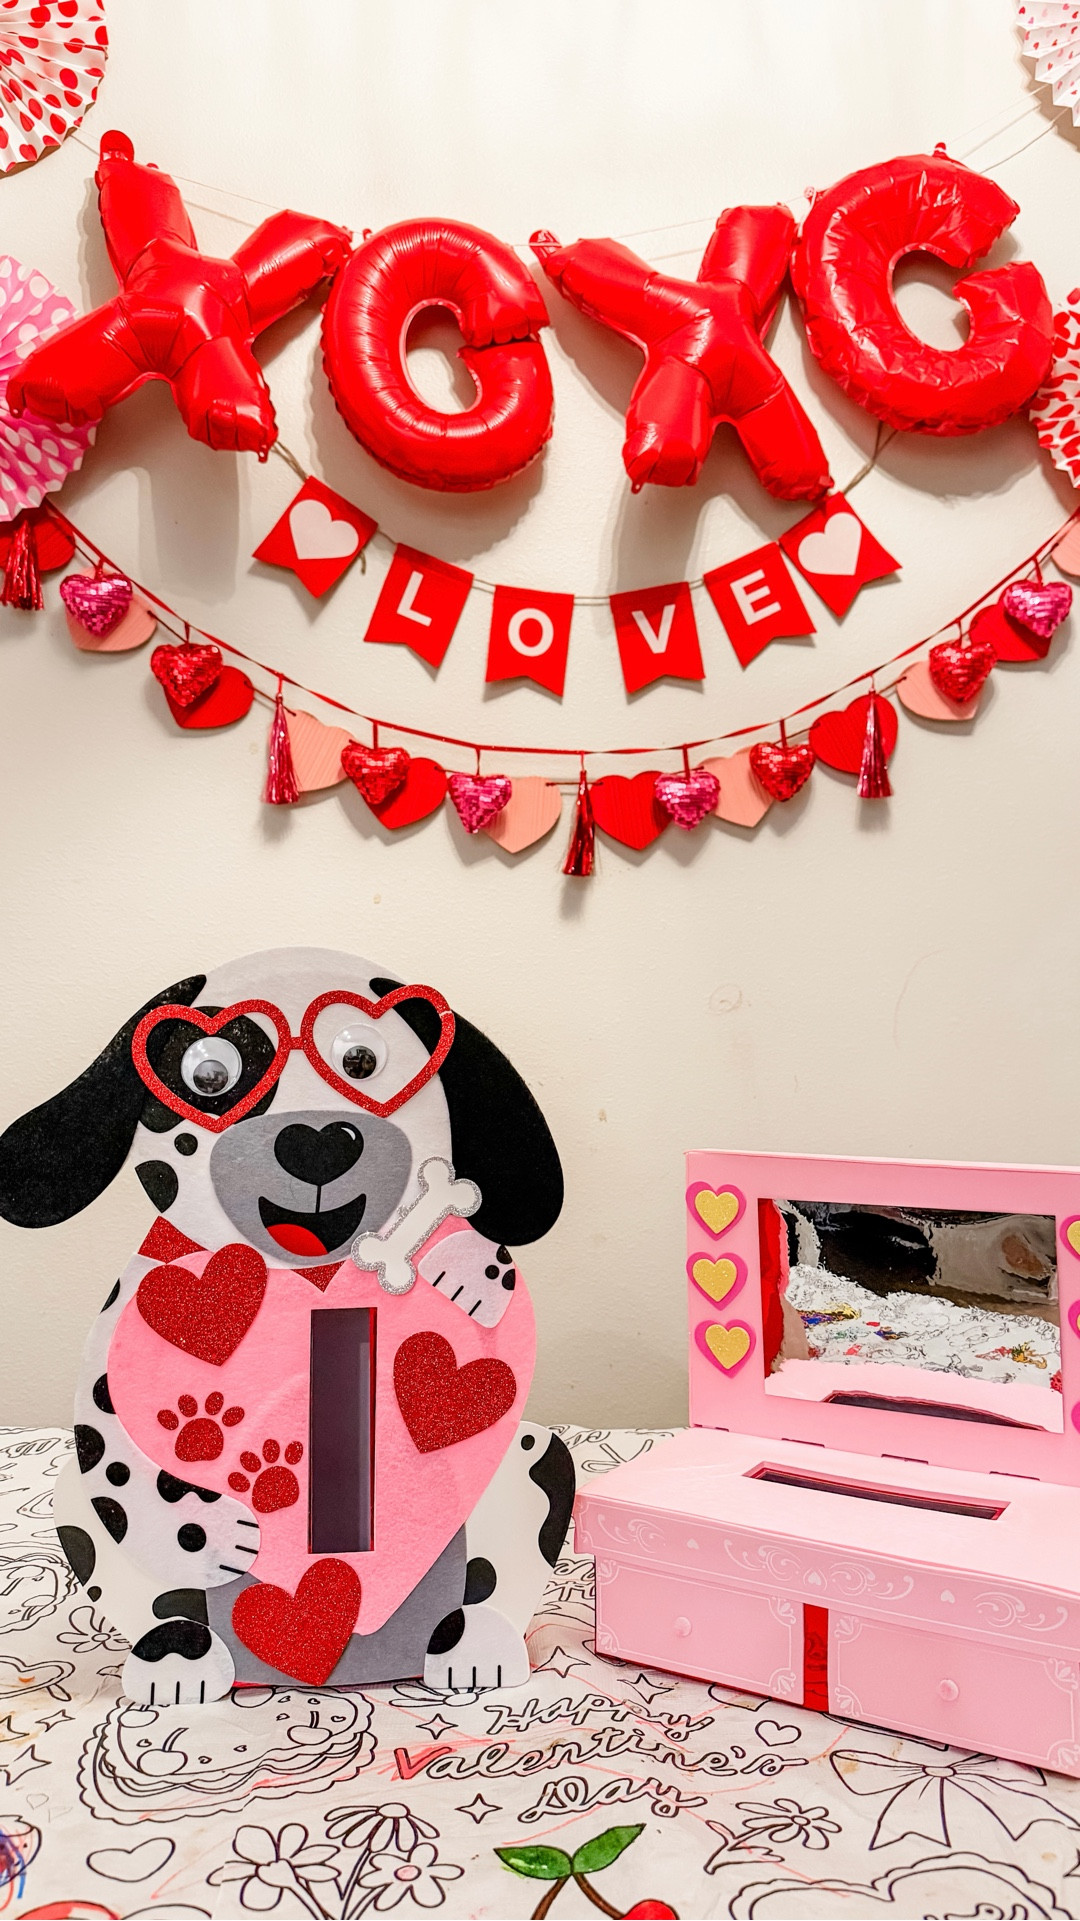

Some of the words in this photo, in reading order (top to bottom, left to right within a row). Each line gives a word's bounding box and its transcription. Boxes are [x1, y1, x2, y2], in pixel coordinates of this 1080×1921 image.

[396, 568, 781, 658] LOVE
[483, 1693, 715, 1743] Happy
[393, 1726, 809, 1781] Valentine's
[517, 1776, 708, 1824] Day
